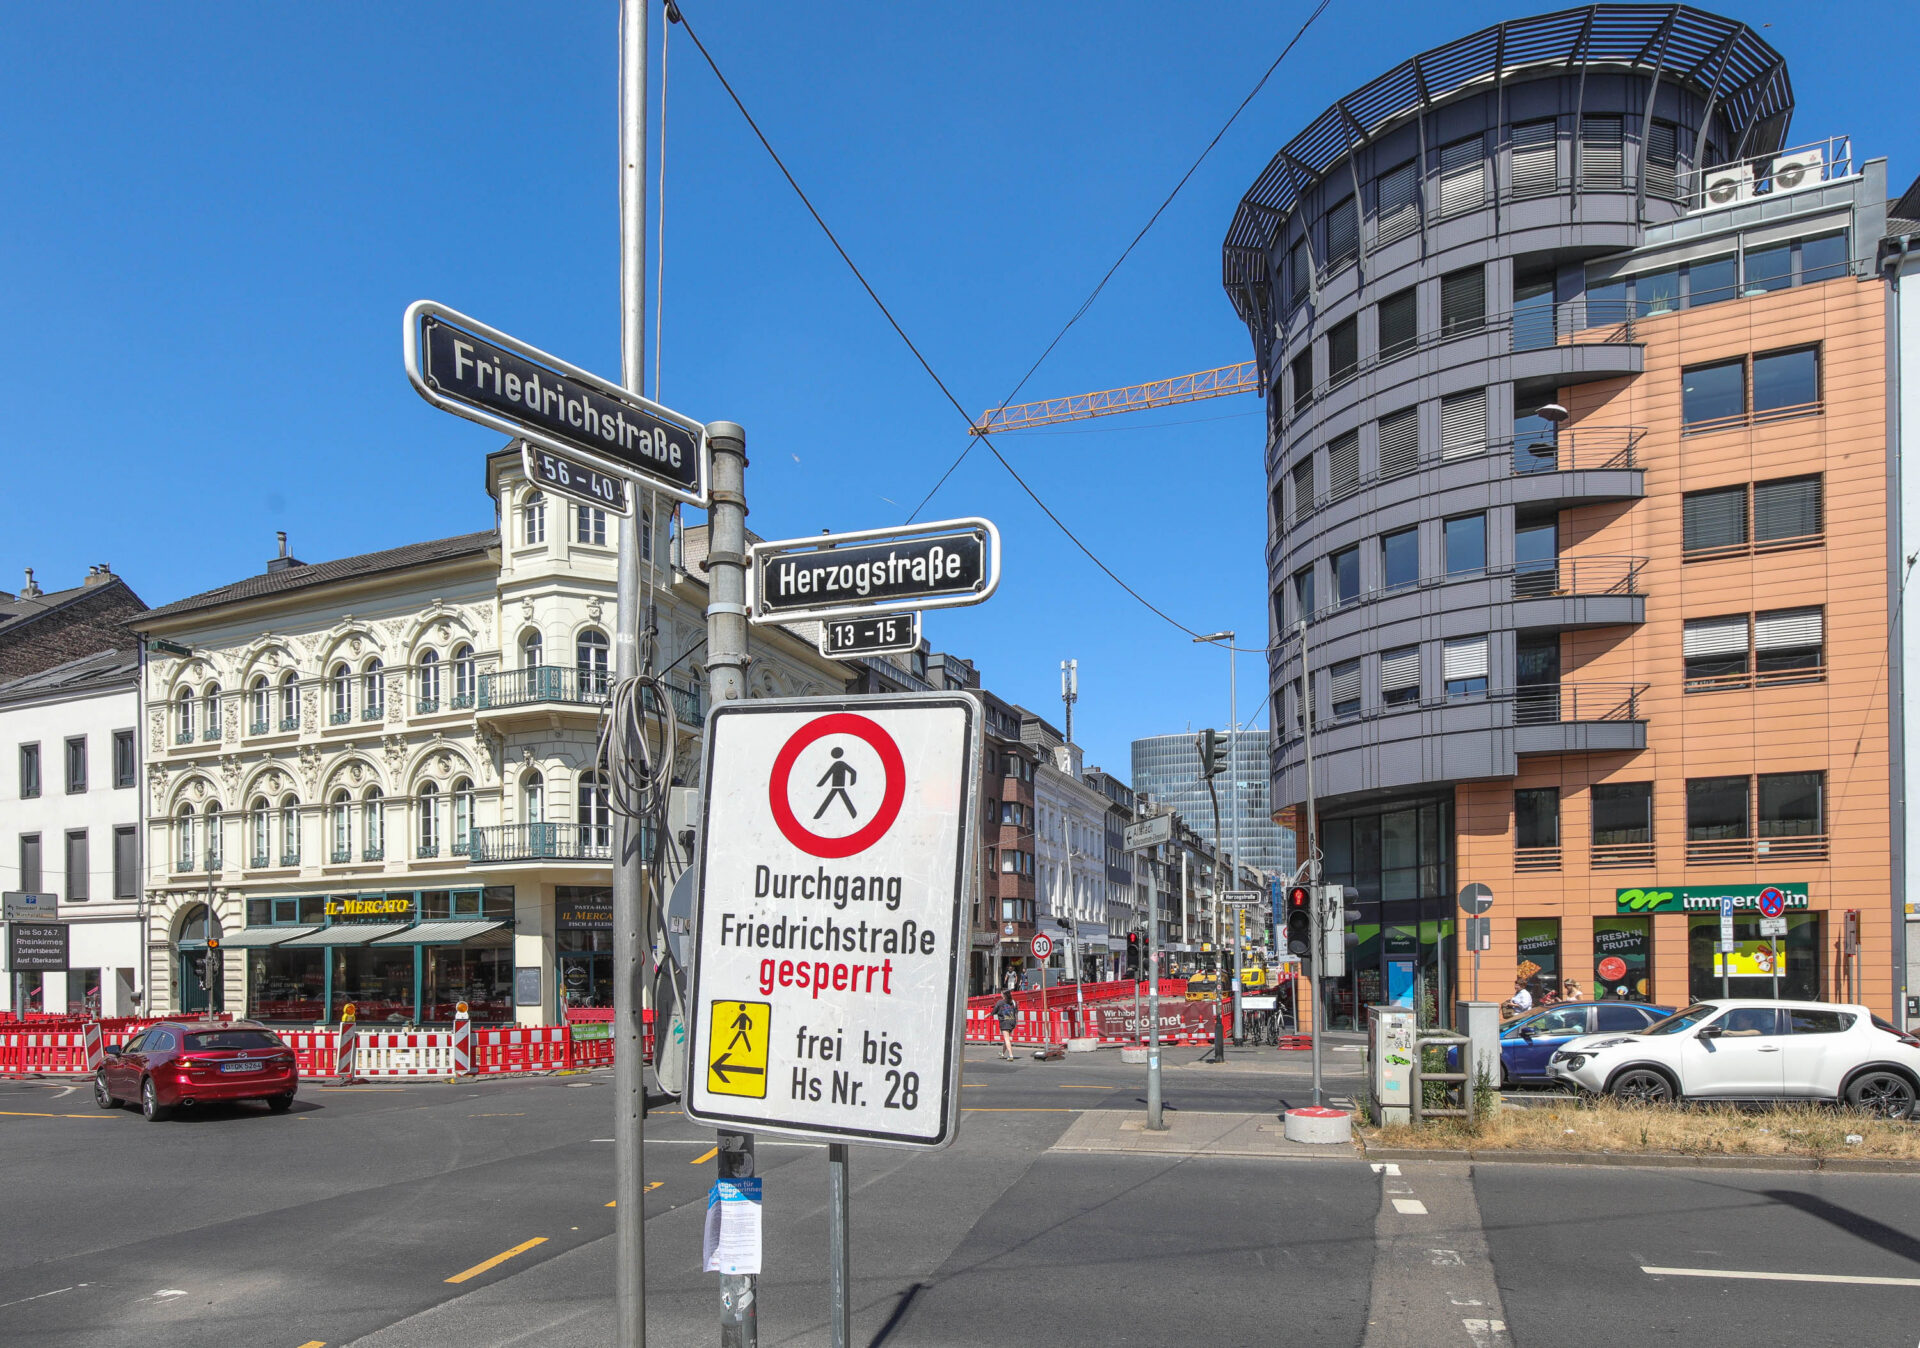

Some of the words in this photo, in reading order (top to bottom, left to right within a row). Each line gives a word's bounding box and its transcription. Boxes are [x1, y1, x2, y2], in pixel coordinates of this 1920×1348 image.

[453, 338, 682, 470] Friedrichstraße
[544, 459, 569, 486] 56
[591, 478, 615, 501] 40
[779, 546, 961, 595] Herzogstraße
[755, 865, 902, 910] Durchgang
[325, 902, 338, 915] IL
[342, 899, 409, 915] MERCATO
[1683, 890, 1807, 909] imerün
[562, 912, 572, 920] IL
[575, 911, 613, 920] MERCA
[721, 913, 936, 955] Friedrichstraße
[1522, 934, 1549, 944] SWEET
[1596, 931, 1631, 943] FRESH
[1035, 941, 1048, 952] 30
[1518, 939, 1556, 951] FRIENDS!
[1602, 938, 1642, 951] FRUITY
[759, 958, 893, 999] gesperrt
[1125, 1014, 1181, 1031] gönet
[797, 1025, 842, 1062] frei
[863, 1031, 903, 1066] bis
[791, 1067, 823, 1101] Hs
[831, 1072, 866, 1106] Nr.
[884, 1070, 919, 1111] 28
